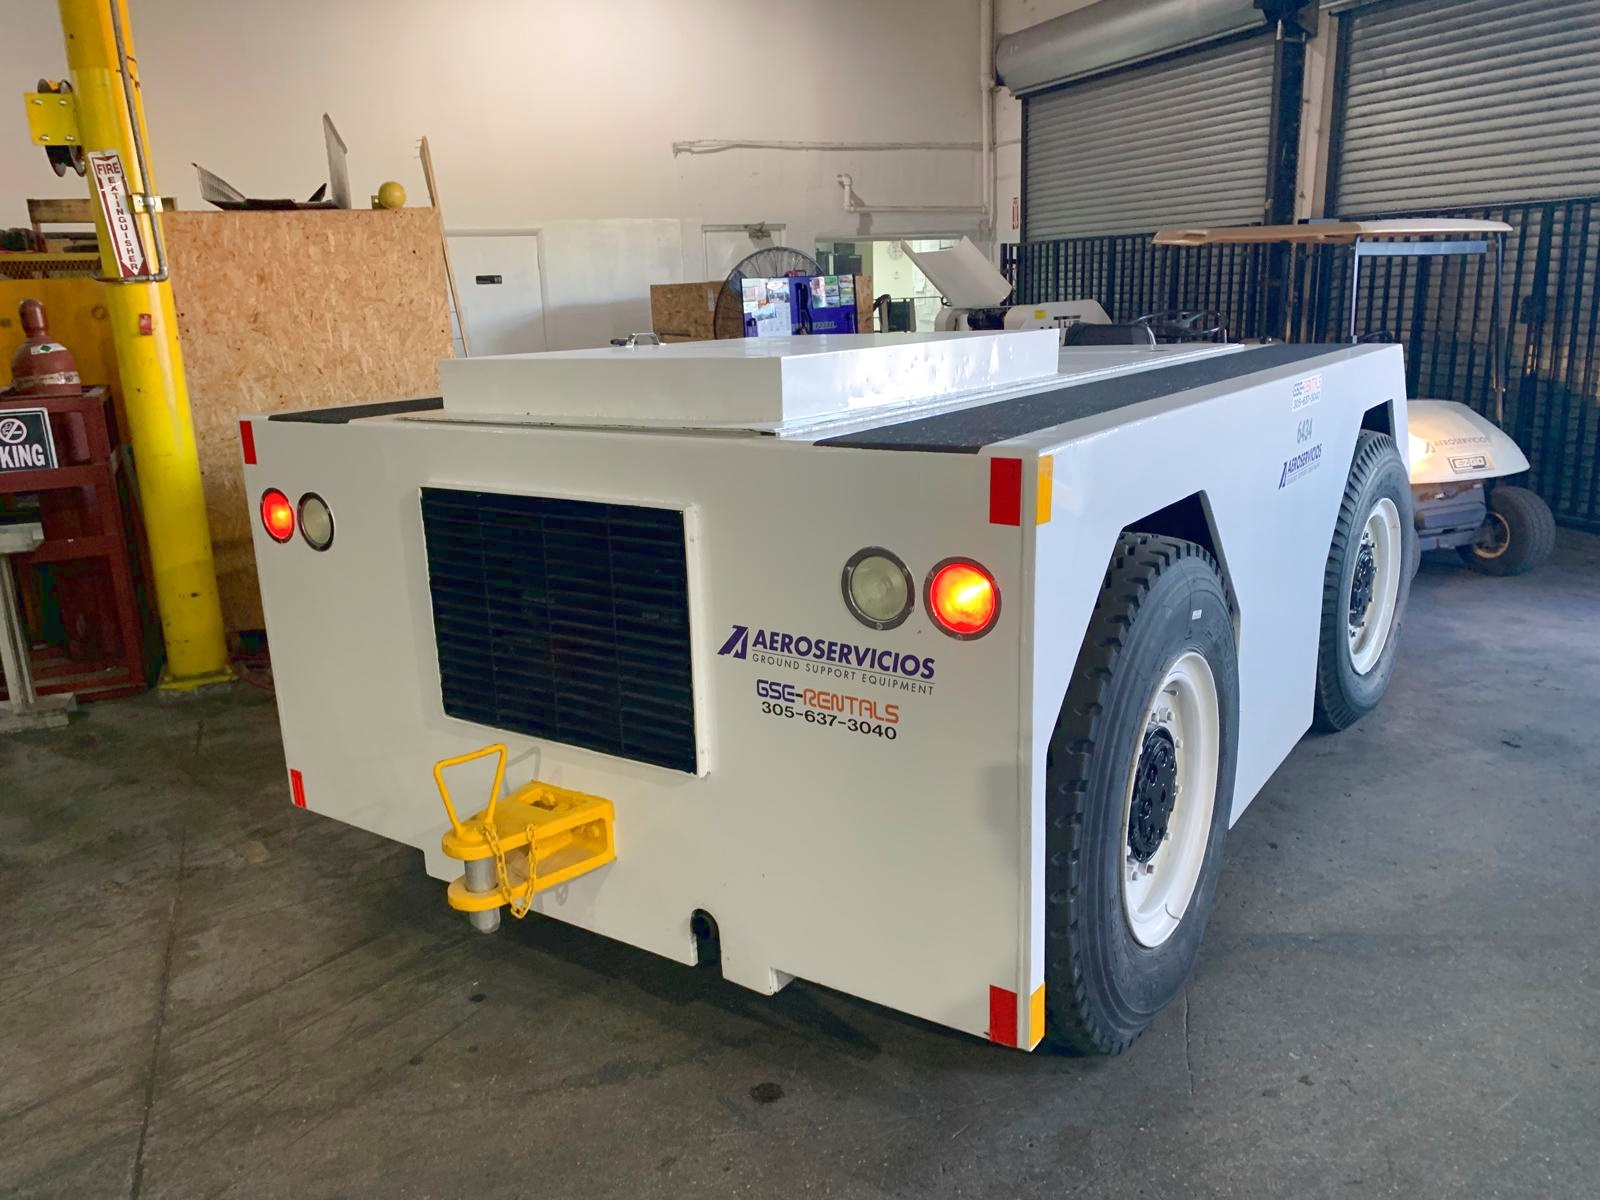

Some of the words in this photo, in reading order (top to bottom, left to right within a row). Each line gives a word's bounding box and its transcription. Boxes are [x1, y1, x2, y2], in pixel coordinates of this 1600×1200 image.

[96, 162, 120, 175] FIRE
[107, 176, 139, 270] EXTINGUISHER
[1297, 417, 1313, 444] 6434
[0, 443, 46, 468] KING
[1288, 443, 1323, 473] AEROSERVICIOS
[752, 629, 936, 680] AEROSERVICIOS
[752, 653, 800, 670] GROUND
[805, 663, 856, 681] SUPPORT
[861, 673, 934, 696] EQUIPMENT
[756, 678, 899, 724] GSE-RENTALS
[761, 701, 897, 740] 305-637-3040
